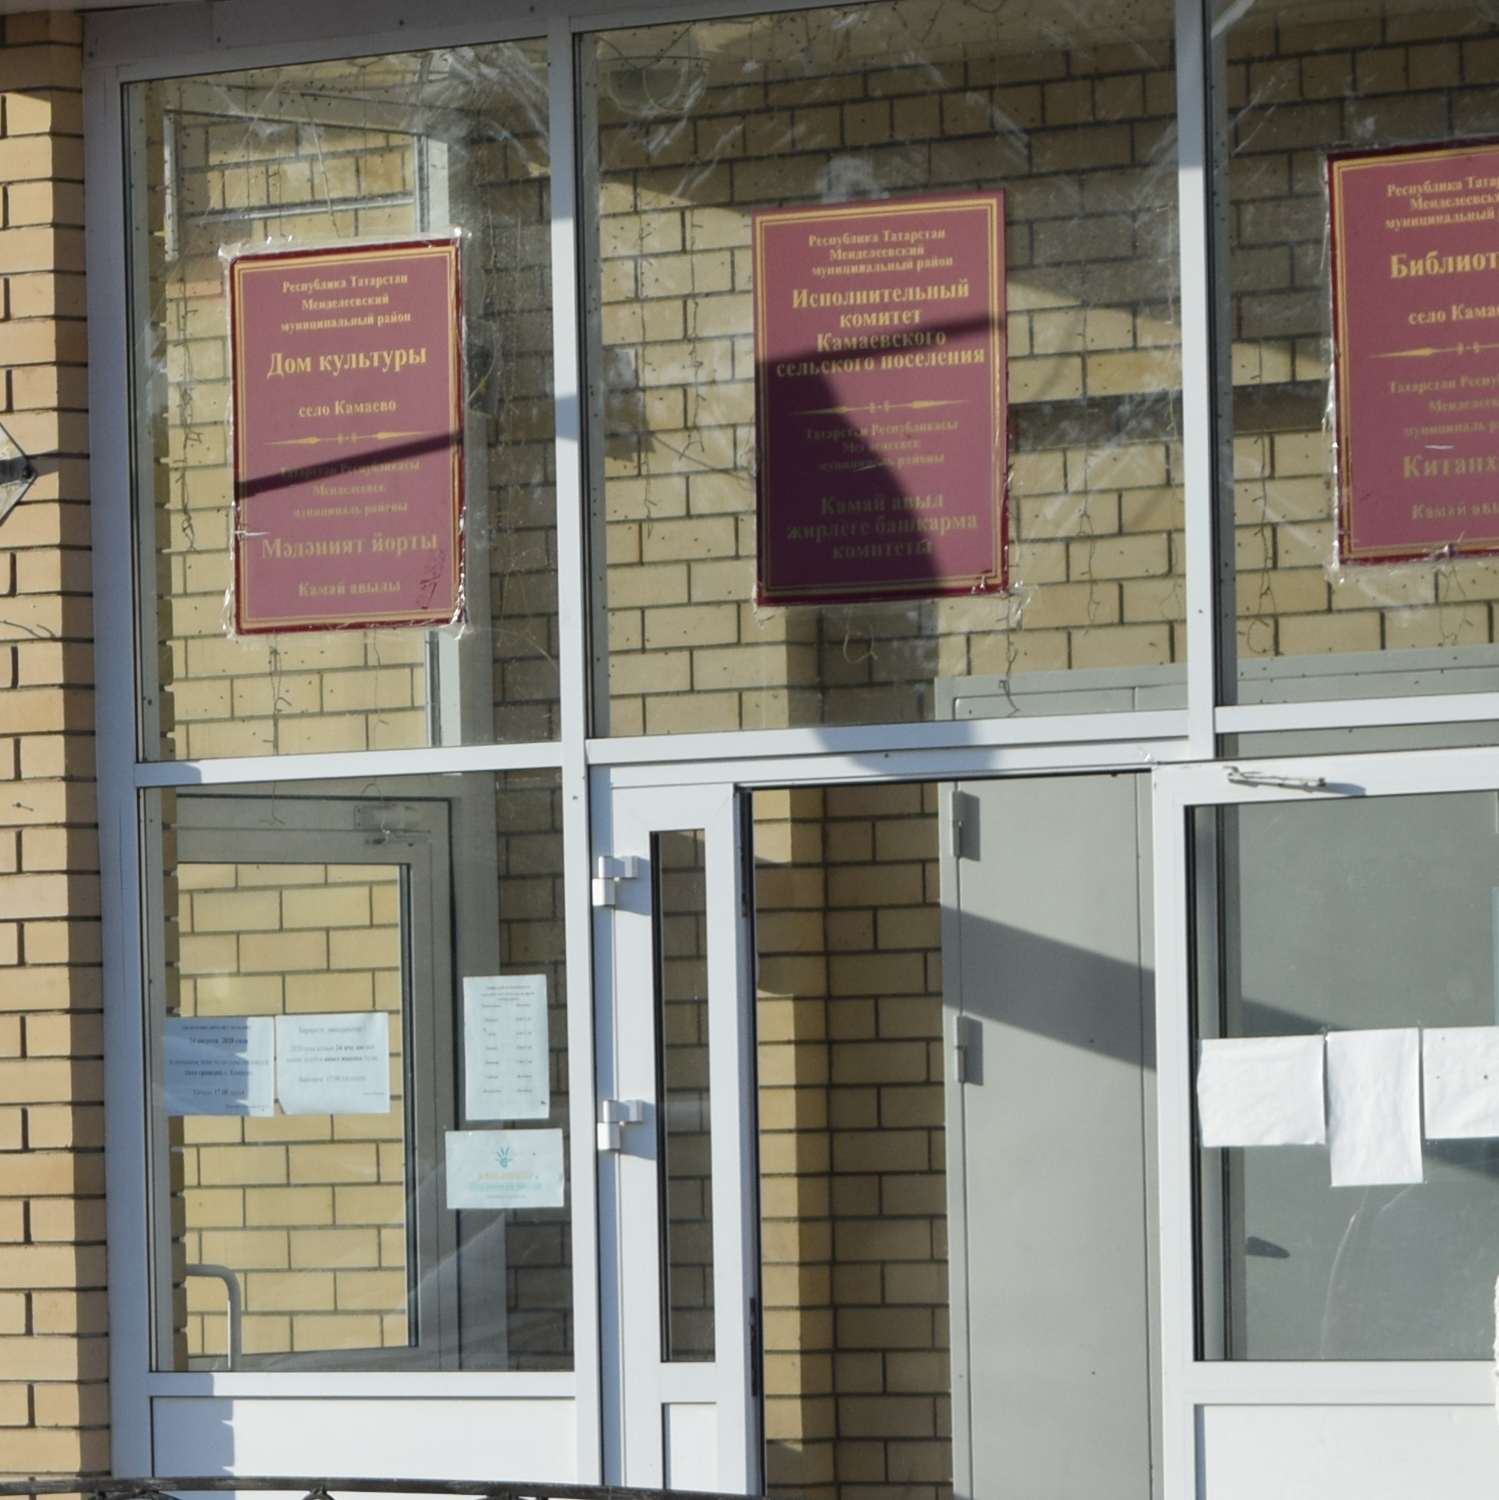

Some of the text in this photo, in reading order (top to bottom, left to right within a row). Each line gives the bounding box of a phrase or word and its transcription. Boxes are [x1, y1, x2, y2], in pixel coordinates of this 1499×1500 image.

[1387, 176, 1499, 197] Республика Тата
[809, 229, 945, 248] Республика Татарстан
[830, 243, 924, 261] Менделеевский
[812, 255, 953, 279] муниципальный район
[282, 274, 408, 294] Республика Татарстан
[792, 278, 969, 308] Исполнительный
[302, 293, 389, 310] Менделеевский
[281, 312, 411, 334] муниципальный район
[840, 309, 923, 328] комитет
[1408, 310, 1446, 325] село
[817, 330, 947, 352] Камаевского
[267, 347, 427, 380] Дом культуры
[776, 348, 985, 377] сельского поселения
[299, 400, 396, 417] село Камаево
[821, 493, 944, 515] Камай авыл
[262, 532, 437, 558] Мәдәният йорты
[299, 580, 401, 597] Камай авылы
